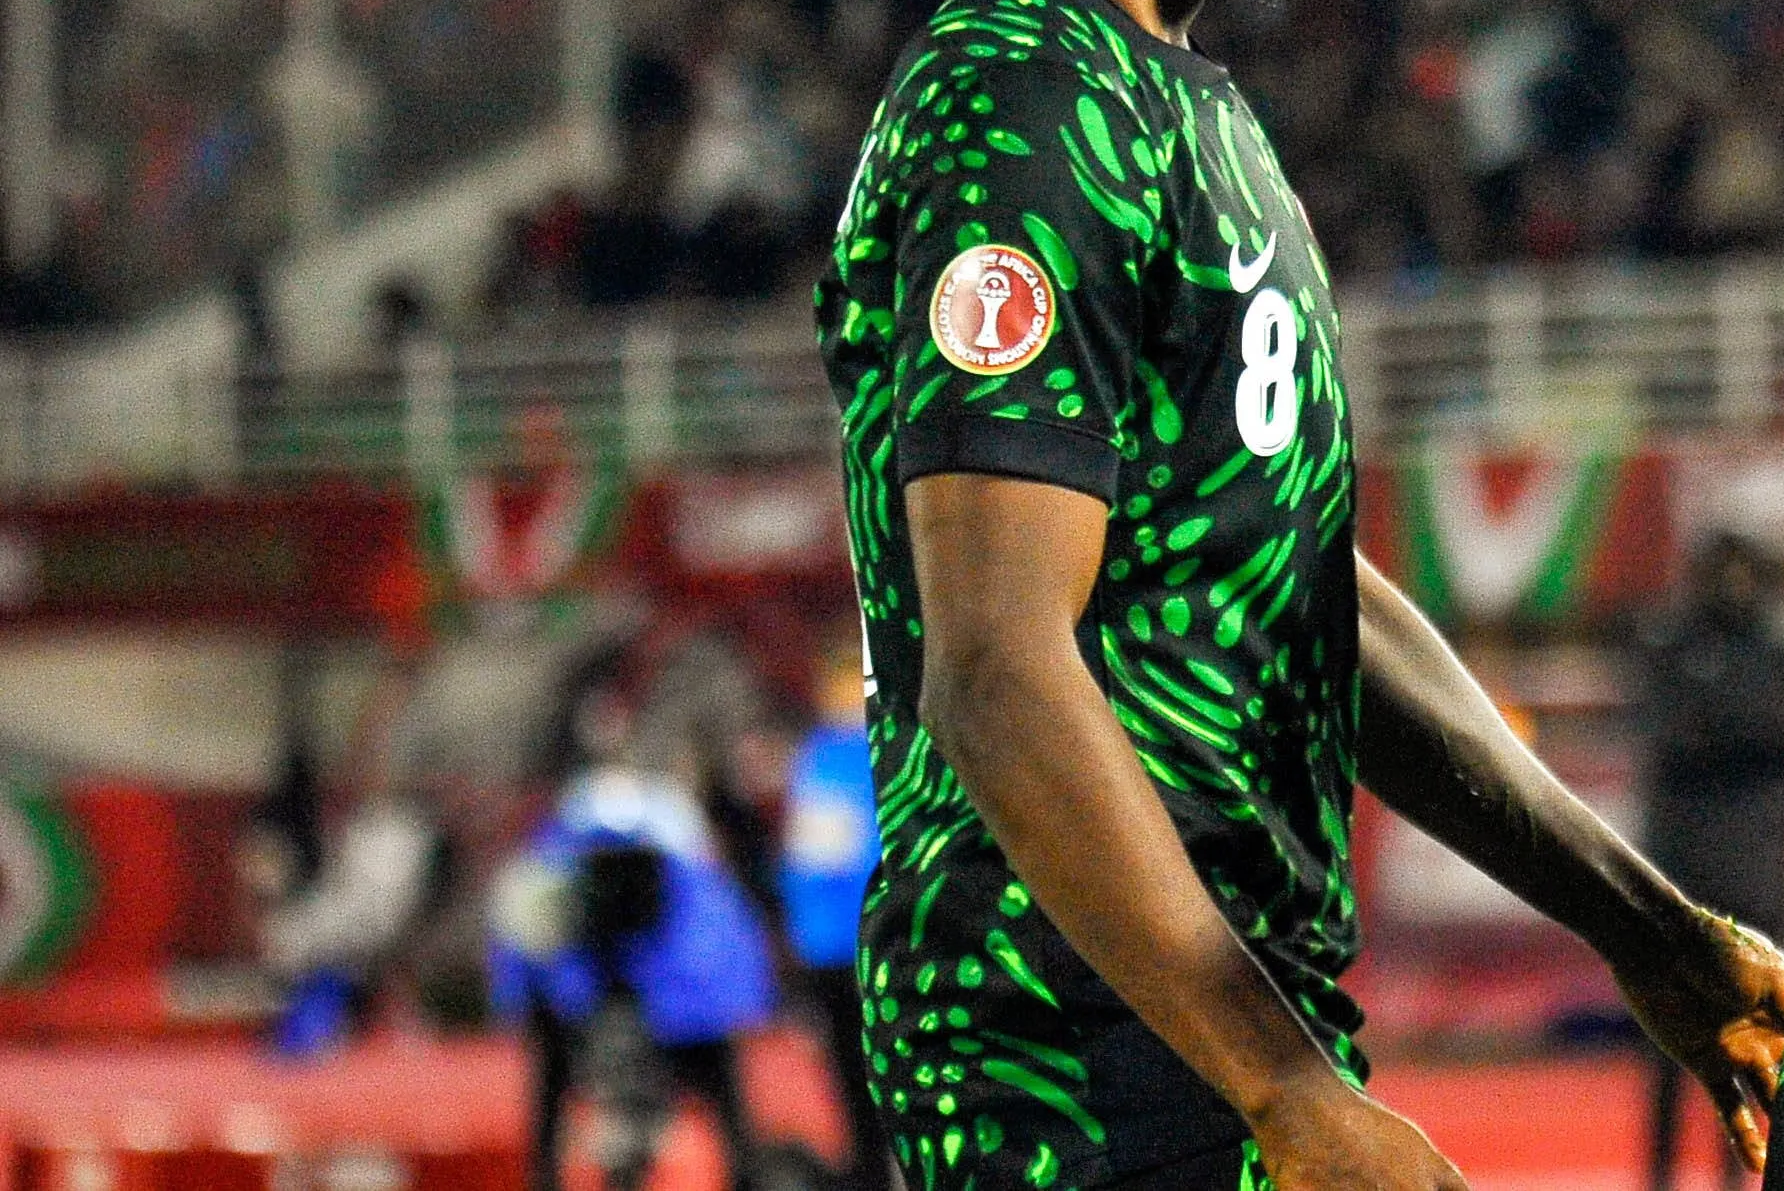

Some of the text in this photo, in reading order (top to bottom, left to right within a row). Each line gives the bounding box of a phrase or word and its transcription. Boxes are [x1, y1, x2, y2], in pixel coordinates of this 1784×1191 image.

[998, 255, 1038, 288] AFRICA
[1032, 287, 1047, 314] CUP
[1235, 287, 1298, 458] 8
